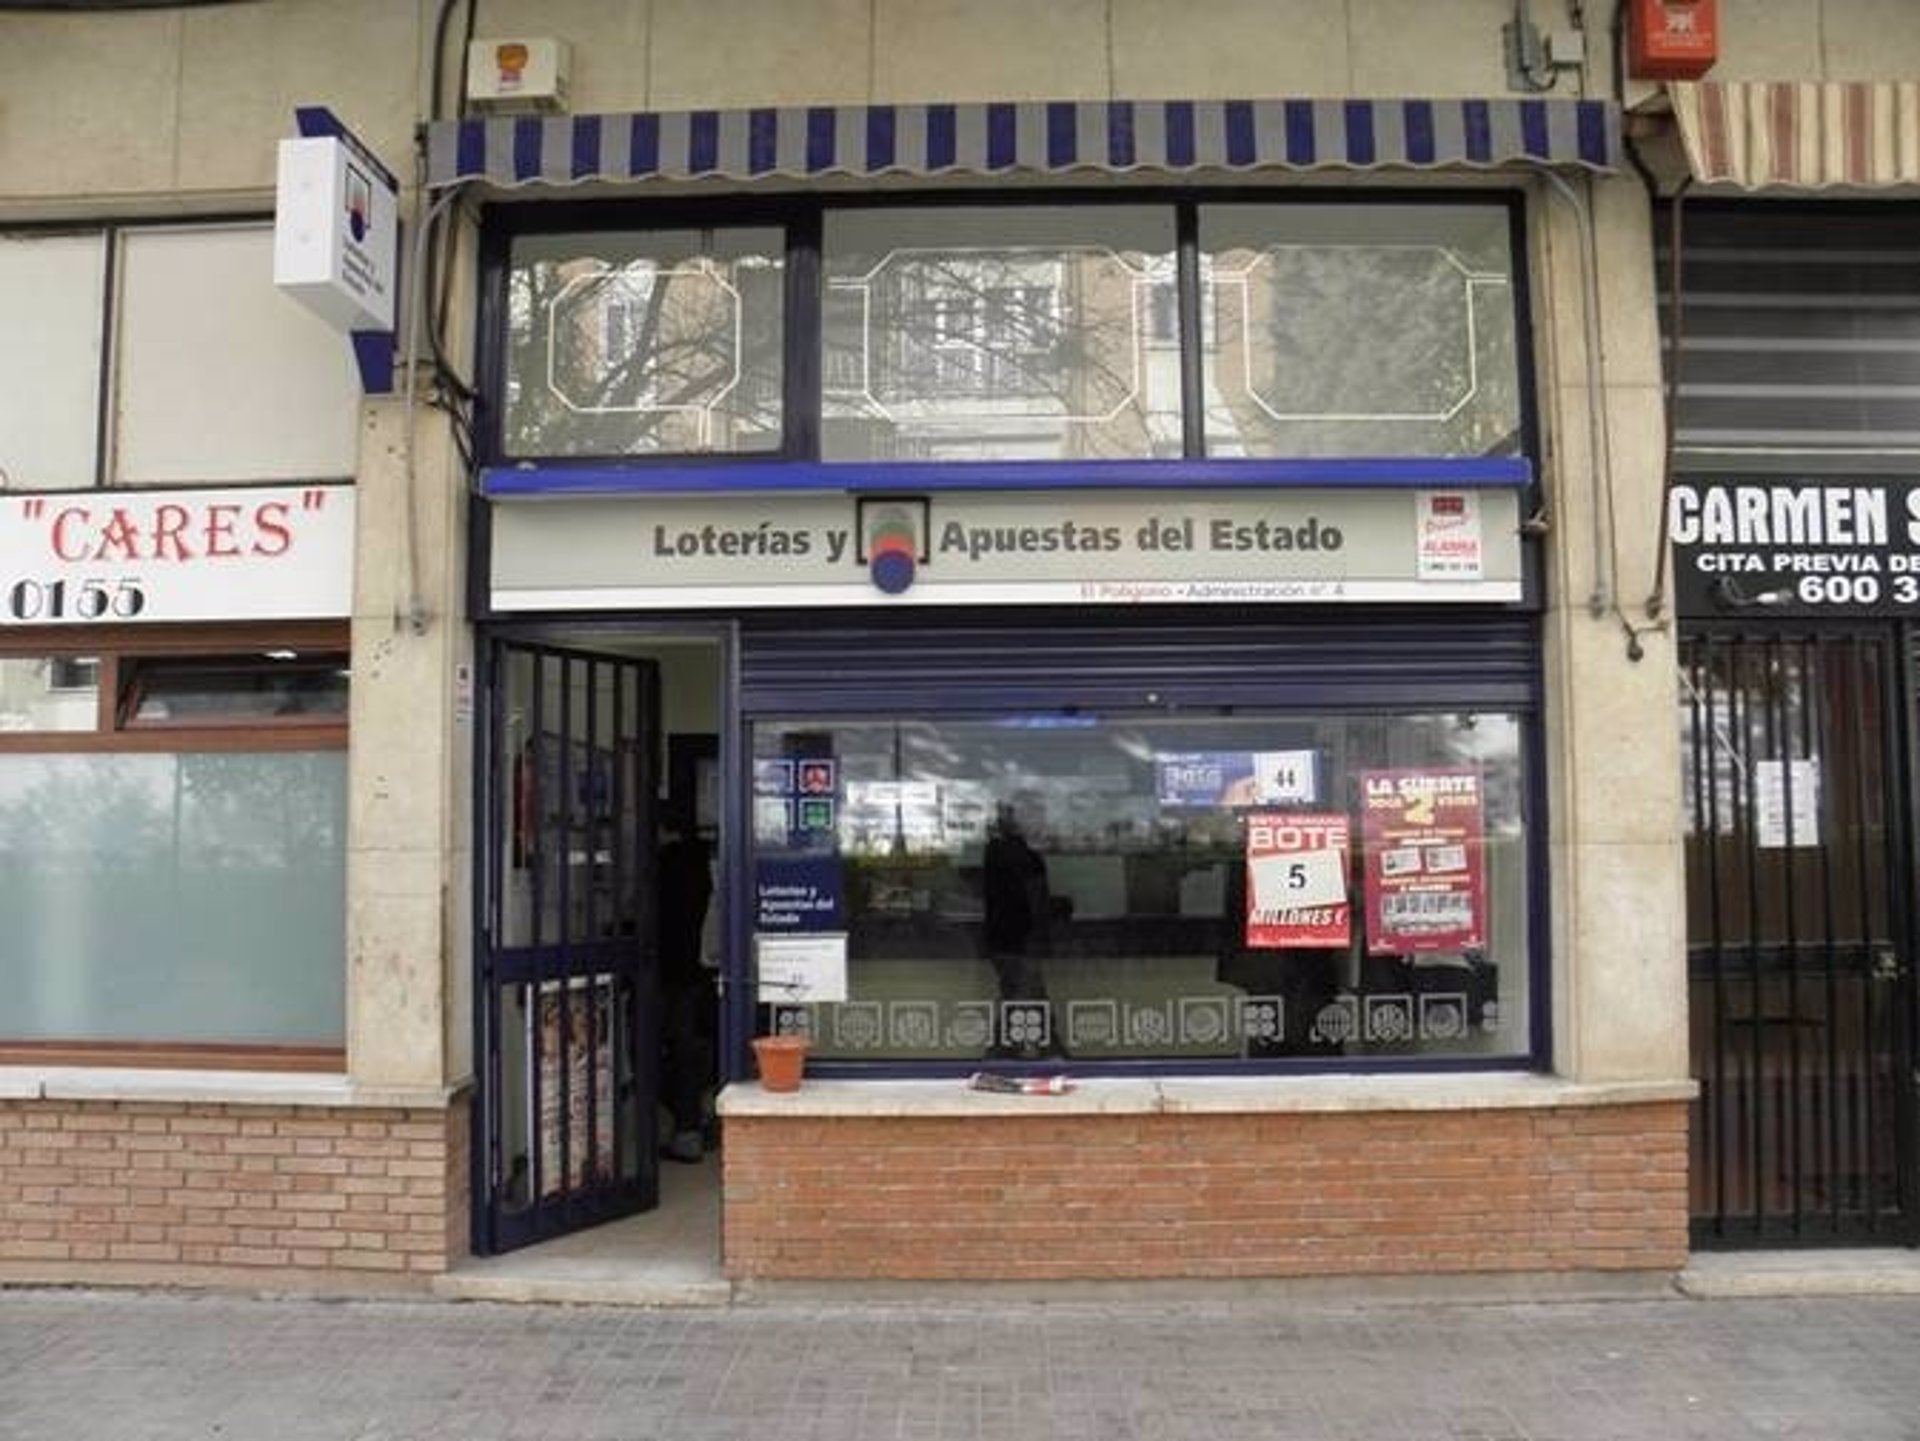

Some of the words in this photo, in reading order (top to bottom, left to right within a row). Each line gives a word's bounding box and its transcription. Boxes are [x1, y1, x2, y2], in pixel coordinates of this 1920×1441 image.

[23, 491, 324, 562] "CARES"
[1669, 485, 1888, 545] CARMEN
[653, 522, 812, 557] Loterías
[827, 530, 848, 562] y
[939, 520, 1121, 560] Apuestas
[1136, 519, 1193, 551] del
[1210, 519, 1343, 551] Estado
[1697, 553, 1766, 572] CITA
[1774, 553, 1881, 572] PREVIA
[10, 575, 145, 620] 0155
[1799, 575, 1879, 603] 600
[1250, 827, 1348, 849] BOTE
[1288, 864, 1306, 888] 5
